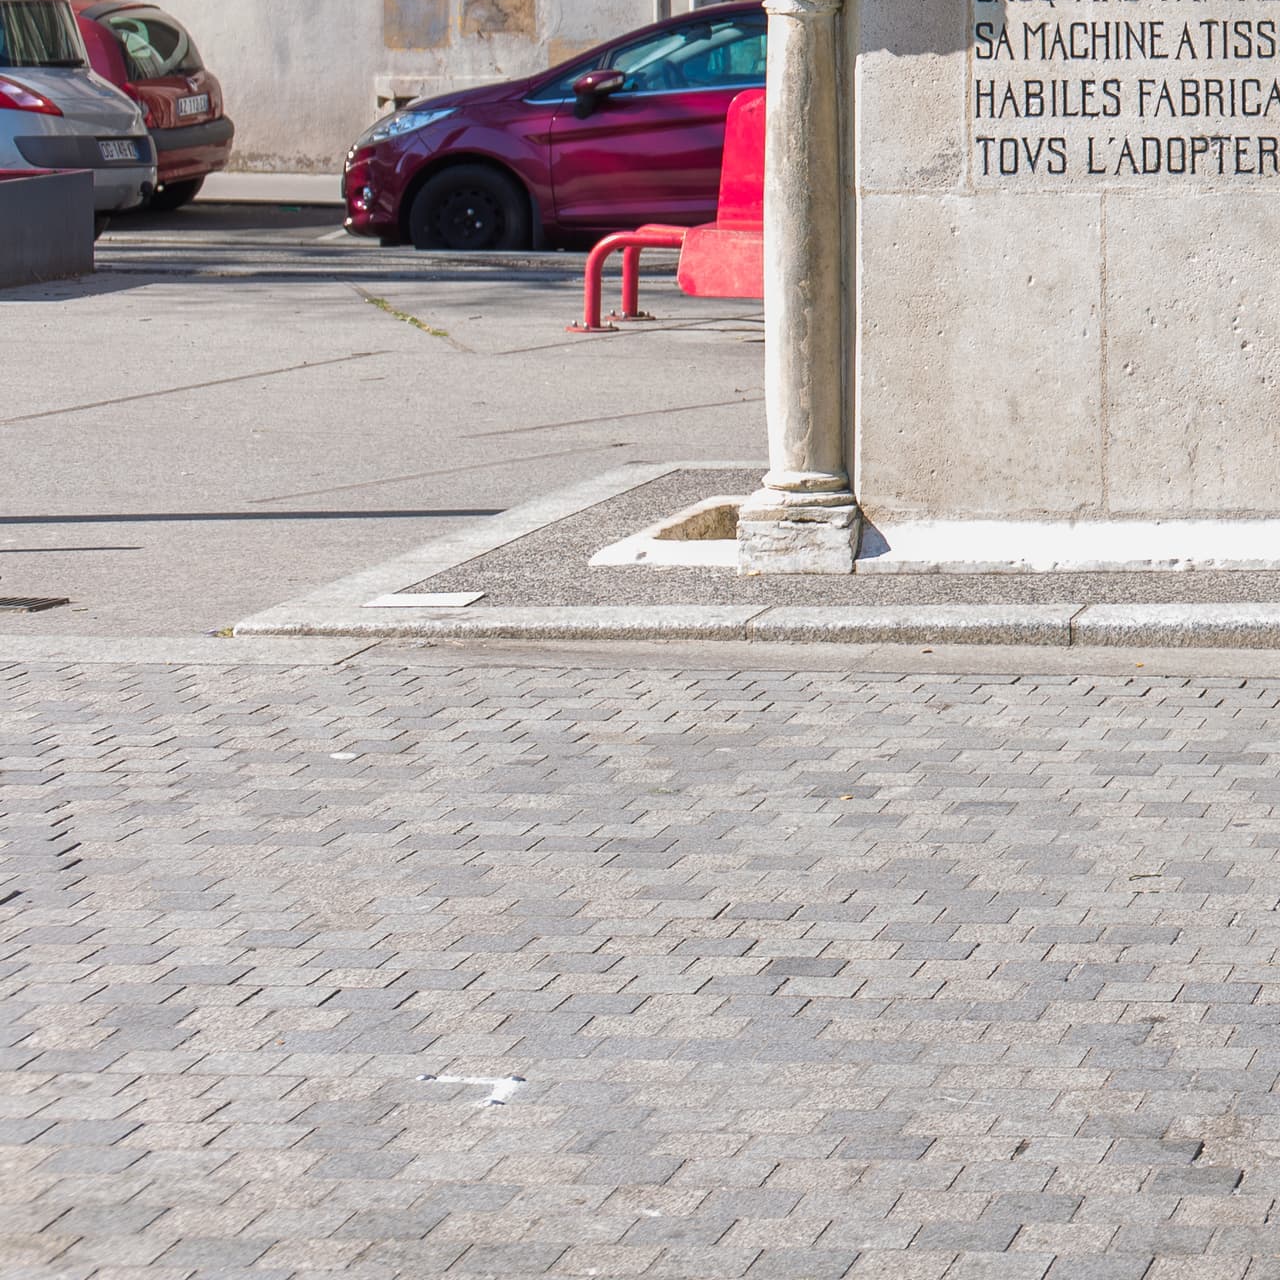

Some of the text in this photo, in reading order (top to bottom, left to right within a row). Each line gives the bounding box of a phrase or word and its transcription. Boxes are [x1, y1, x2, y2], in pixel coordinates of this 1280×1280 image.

[975, 22, 1015, 61] SA
[1022, 21, 1169, 61] MACHINE
[975, 78, 1122, 119] HABILES
[975, 136, 1067, 176] TOVS
